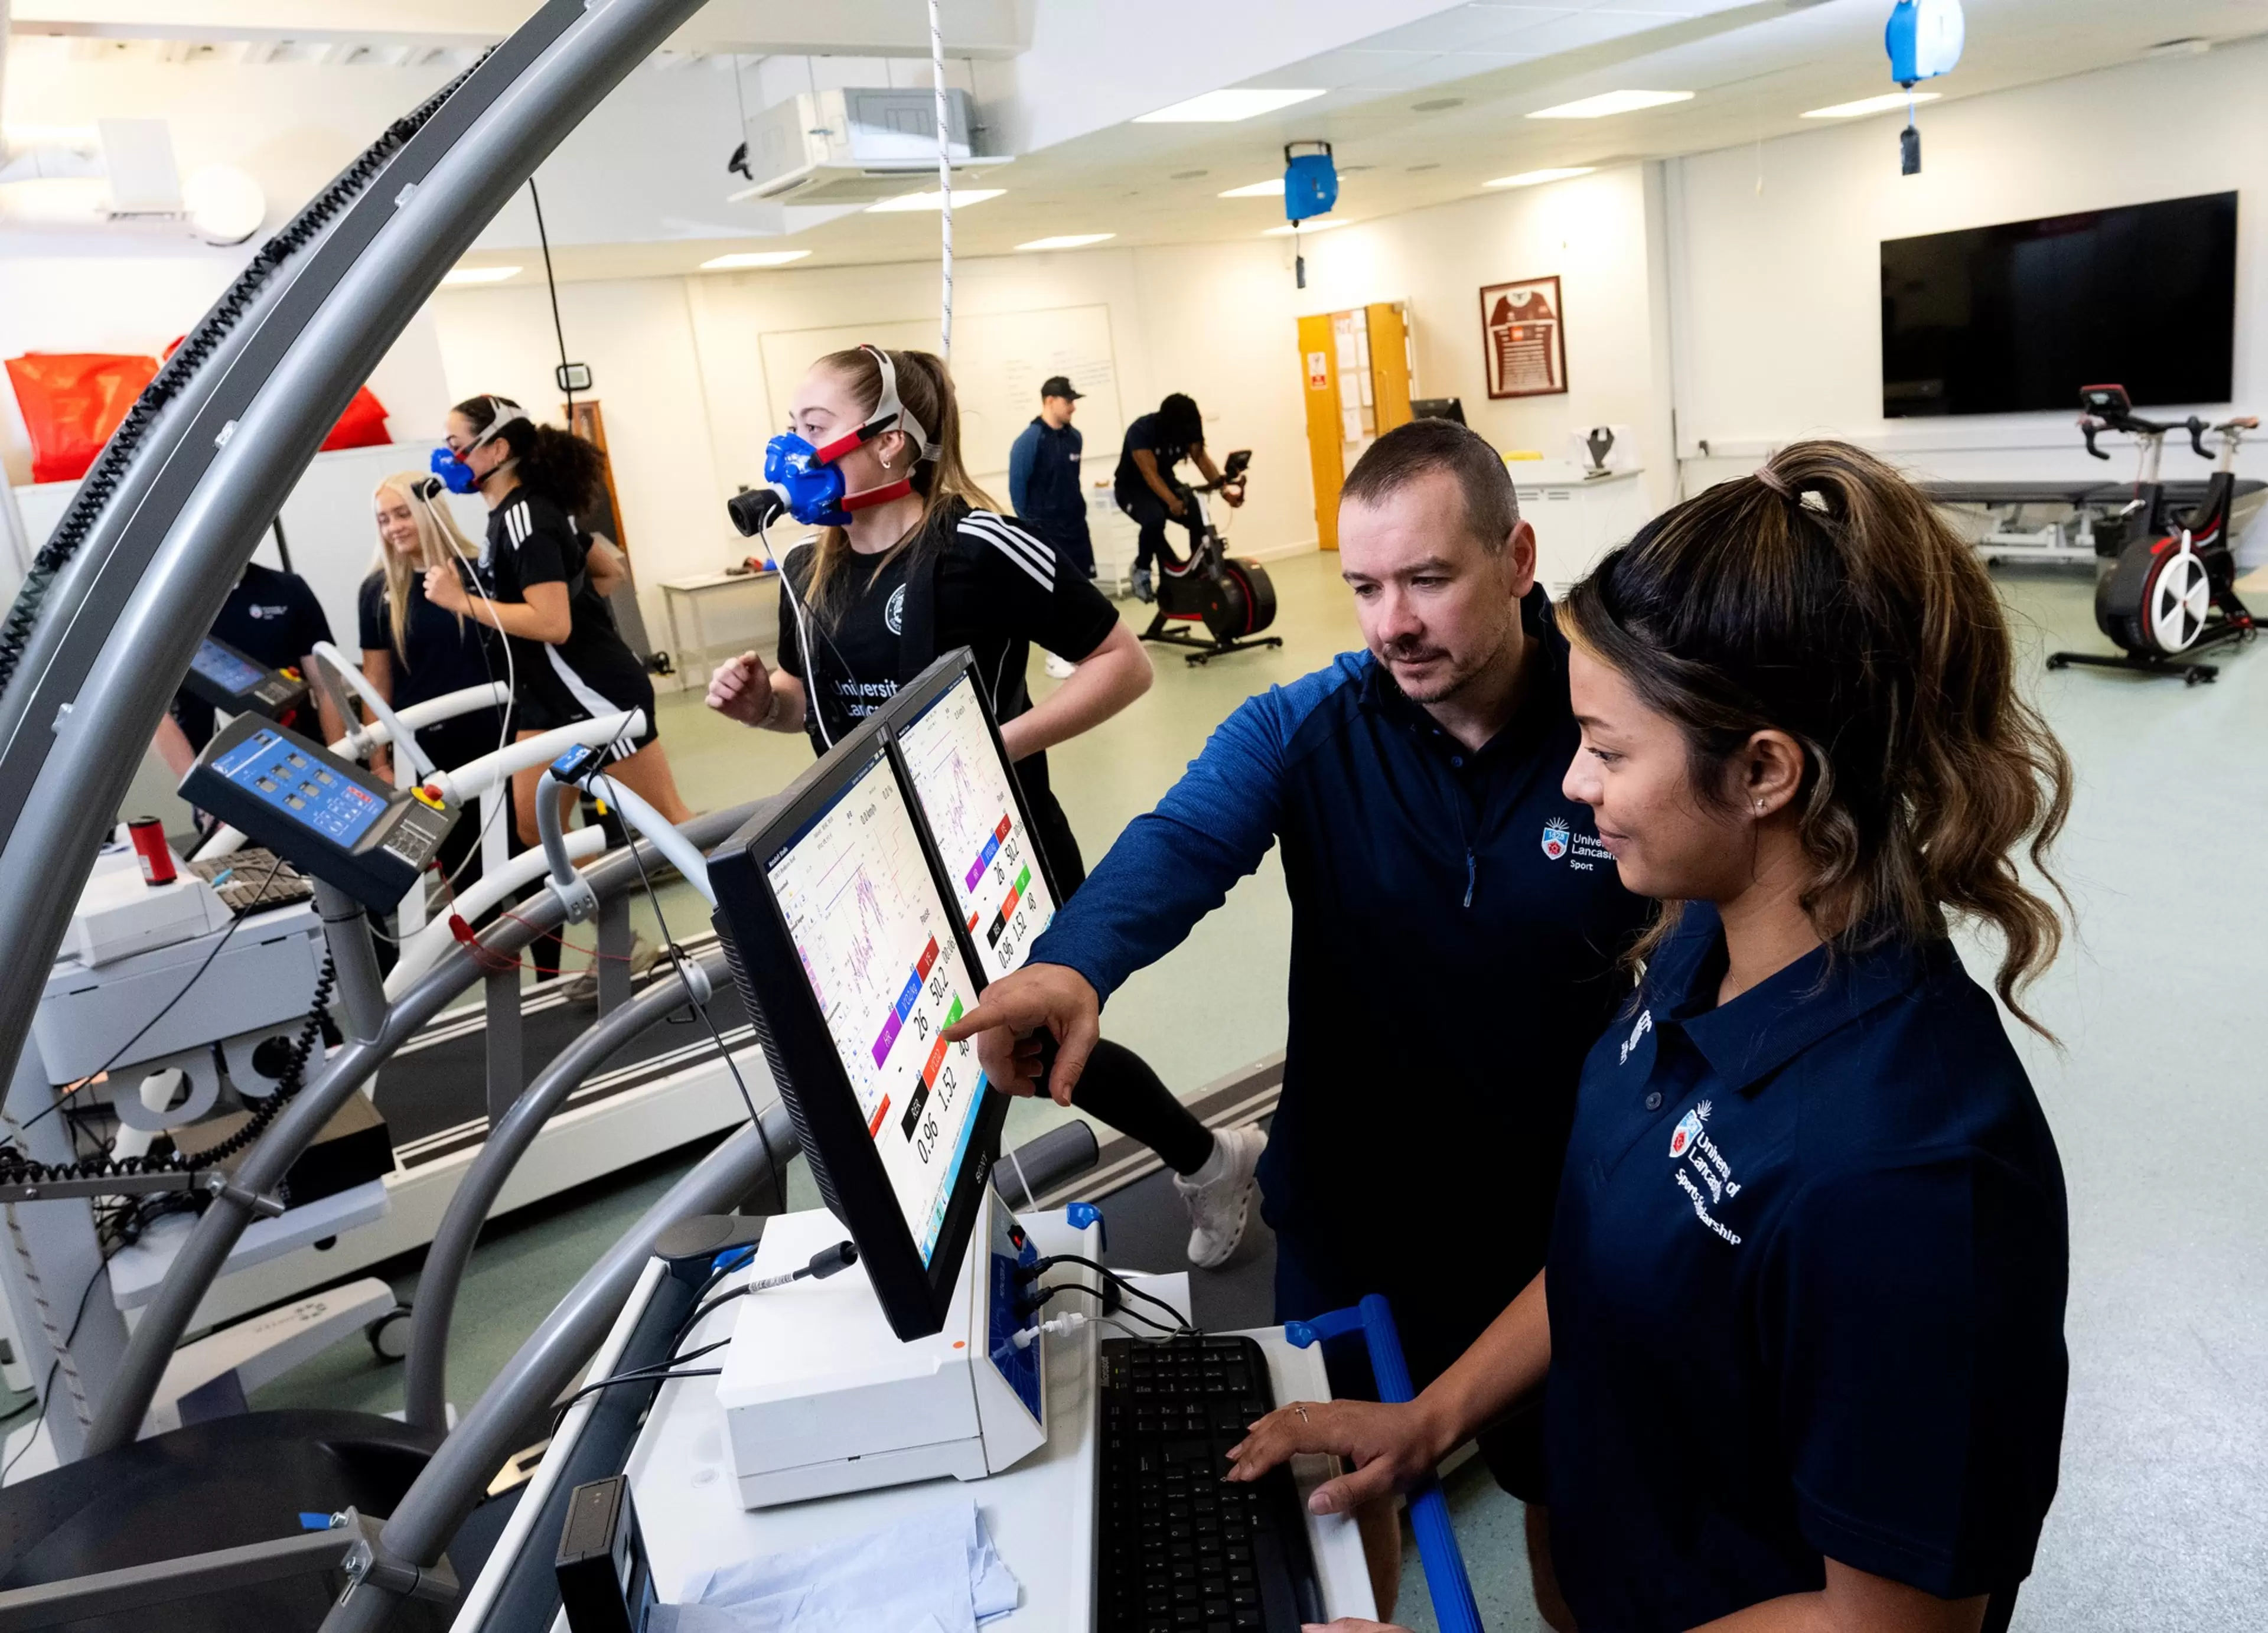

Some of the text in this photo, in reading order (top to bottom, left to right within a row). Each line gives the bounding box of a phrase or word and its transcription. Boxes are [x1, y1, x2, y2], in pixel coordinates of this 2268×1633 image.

[829, 679, 900, 697] Universit
[1572, 843, 1618, 860] Lancash
[1573, 833, 1604, 848] Unive
[993, 837, 1019, 885] 26 50.2
[1570, 859, 1594, 871] Sport
[920, 908, 931, 925] Pause
[998, 892, 1037, 969] 0.96 1.52 48
[913, 966, 949, 1041] 26 50.2
[882, 1030, 892, 1047] HR
[911, 1099, 921, 1120] RER
[917, 1112, 939, 1164] 0.96
[938, 1066, 956, 1112] 1.52
[975, 1150, 988, 1185] SONY
[1696, 1131, 1742, 1198] Univers of
[1675, 1168, 1699, 1201] Sports
[1100, 1356, 1109, 1387] crosoft
